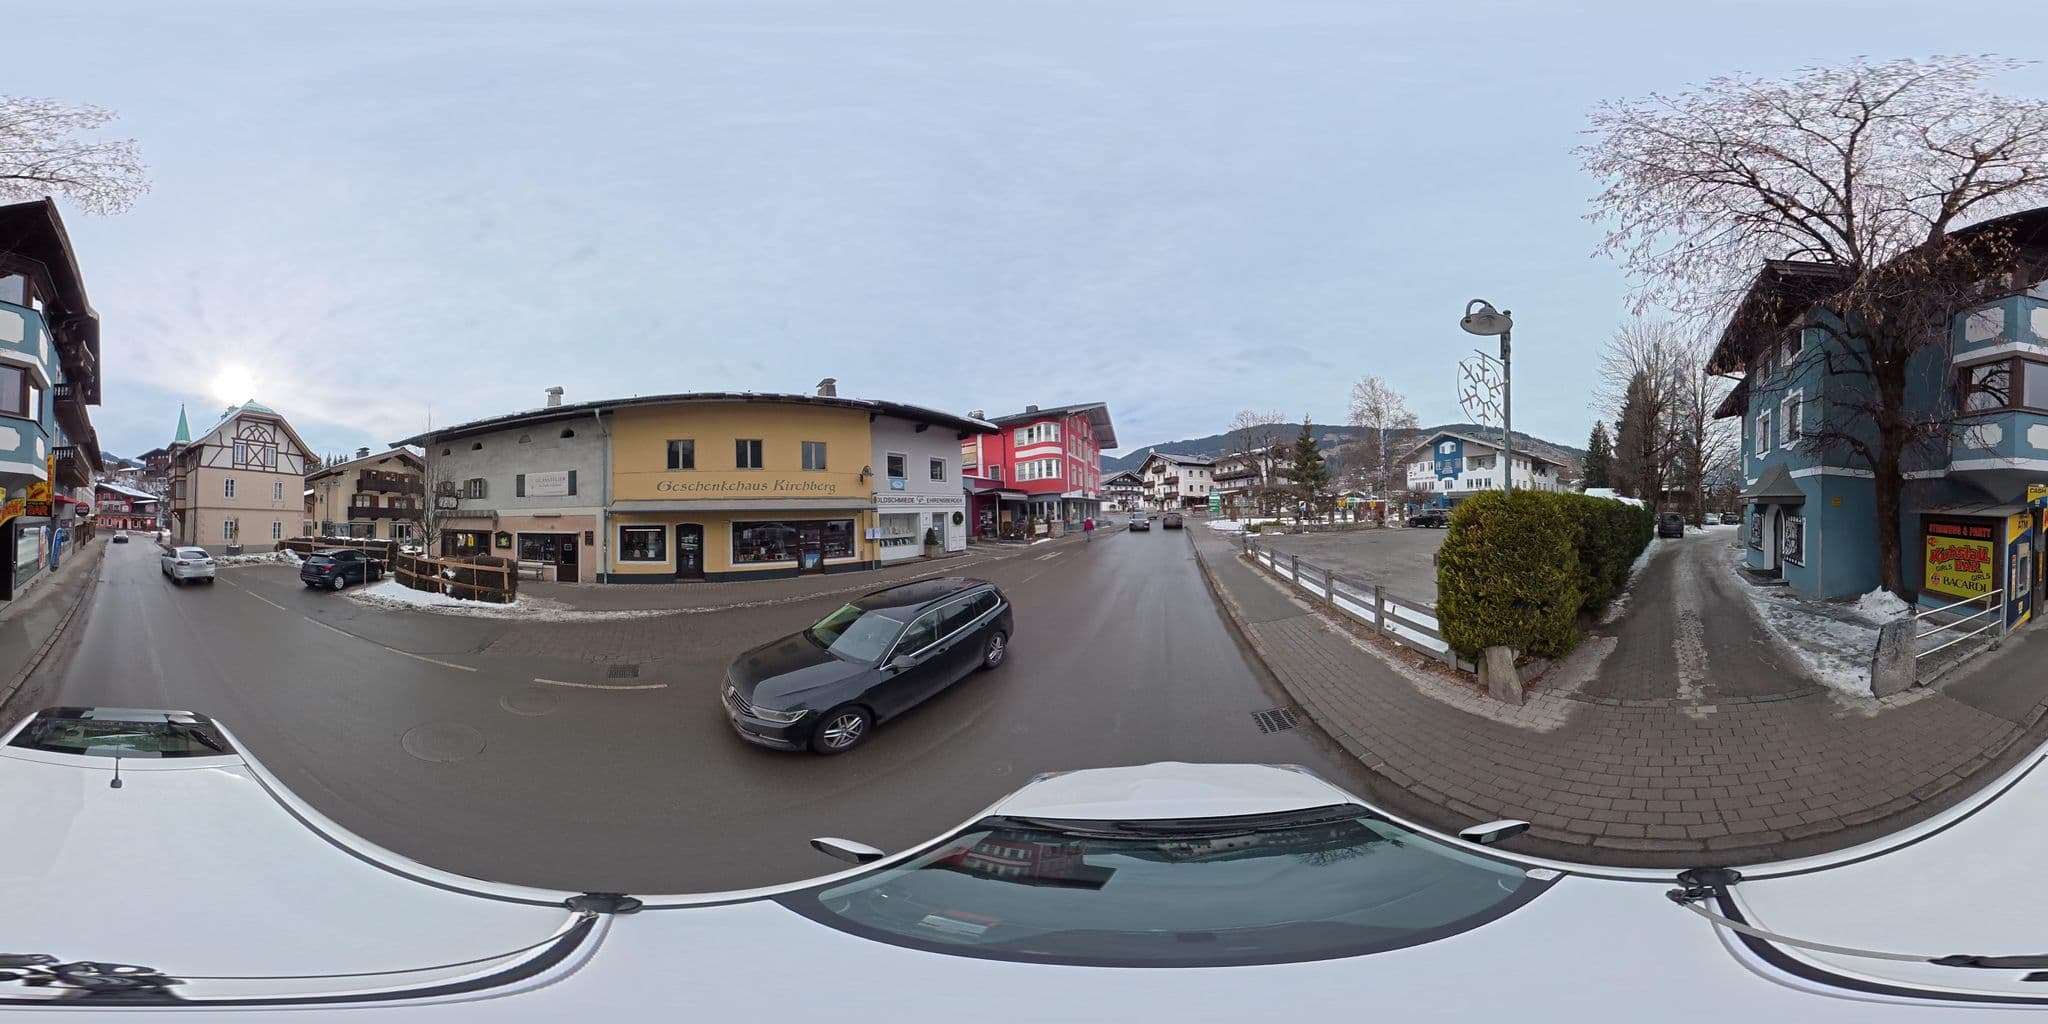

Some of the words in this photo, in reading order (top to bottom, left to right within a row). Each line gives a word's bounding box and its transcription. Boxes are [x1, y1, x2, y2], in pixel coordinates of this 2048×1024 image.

[773, 479, 836, 494] Kirchberg
[2018, 520, 2029, 529] ATM
[1969, 526, 1992, 537] PARTY
[1954, 559, 1982, 573] BAR
[1971, 573, 1991, 581] GIRLS
[1943, 576, 1987, 592] BACARDI
